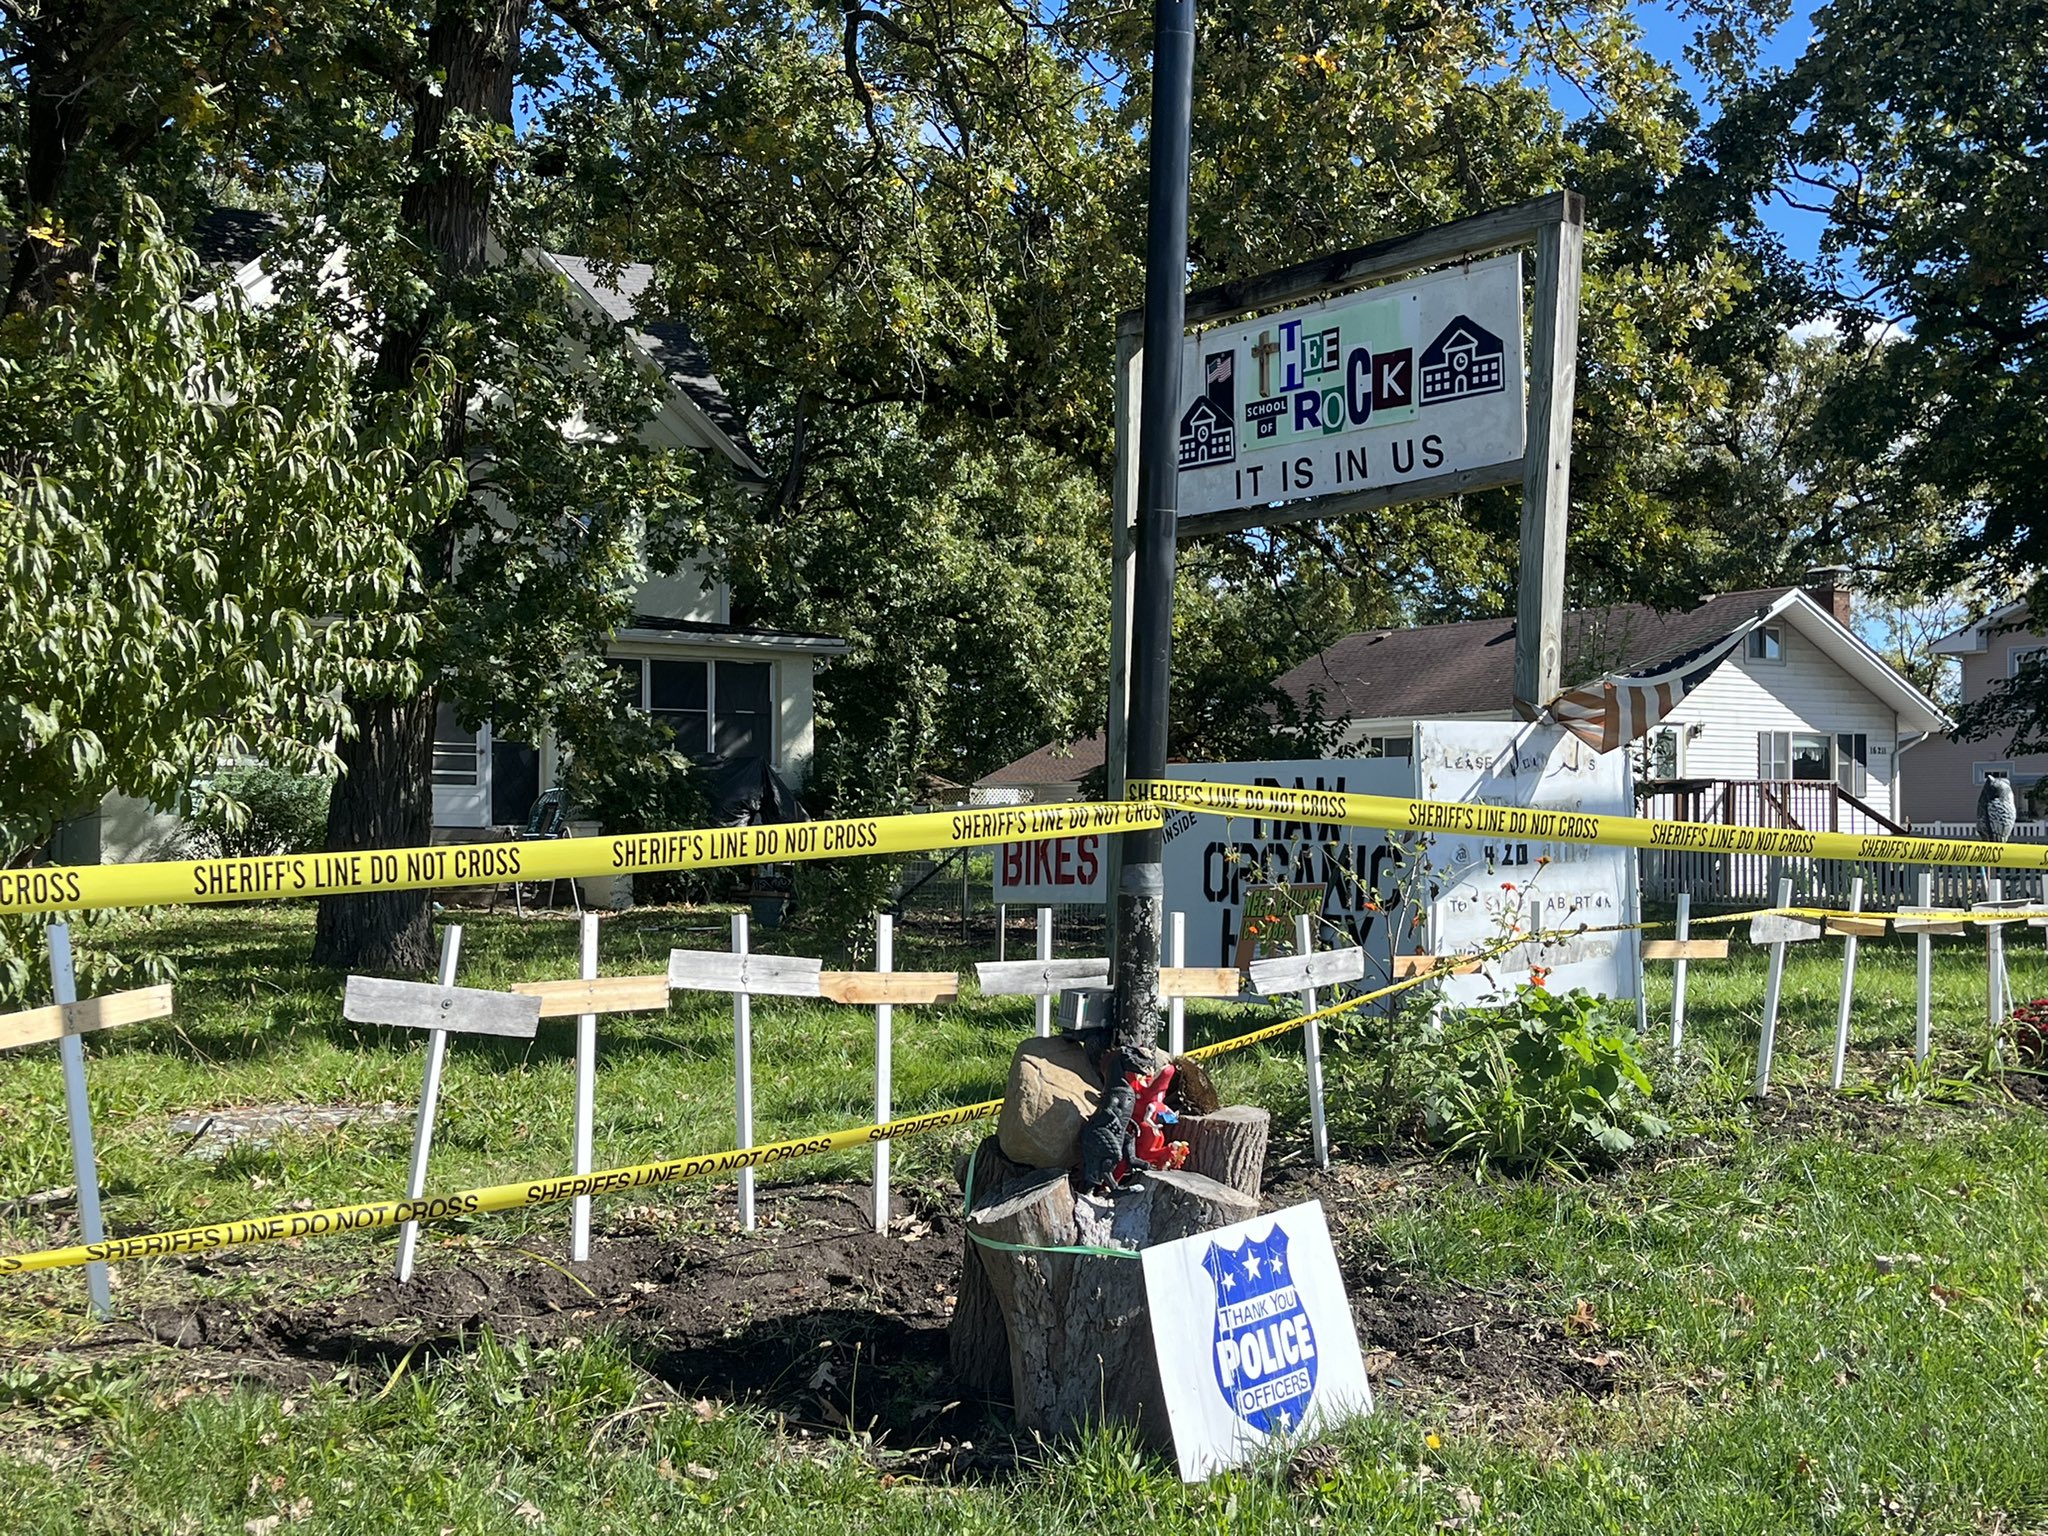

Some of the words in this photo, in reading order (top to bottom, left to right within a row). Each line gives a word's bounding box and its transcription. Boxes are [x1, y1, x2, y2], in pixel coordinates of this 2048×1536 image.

[1294, 347, 1408, 429] ROCK
[1246, 400, 1287, 418] SCHOOL
[1260, 422, 1273, 434] OF
[1235, 465, 1264, 500] IT
[1282, 457, 1314, 492] IS
[1335, 446, 1369, 484] IN
[1391, 434, 1445, 474] US
[1128, 783, 1203, 805] SHERIFF'S
[1207, 787, 1240, 809] LINE
[1246, 790, 1265, 812] DO
[1269, 792, 1297, 815] NOT
[1302, 794, 1347, 819] CROSS
[951, 811, 1027, 841] SHERIFF'S
[1031, 809, 1064, 833] LINE
[1069, 807, 1090, 830] DO
[1094, 804, 1120, 827] NOT
[1125, 803, 1164, 823] CROS
[1162, 811, 1198, 844] INSIDE
[1408, 804, 1474, 830] SHERIFF'S
[1477, 808, 1506, 833] LINE
[1509, 812, 1527, 835] DO
[1530, 814, 1556, 837] NOT
[1558, 816, 1599, 840] CROSS
[1650, 824, 1709, 847] SHERIFF'S
[1708, 827, 1737, 849] LINE
[1736, 829, 1754, 850] DO
[1755, 831, 1780, 852] NOT
[1778, 833, 1816, 854] CROSS
[612, 835, 704, 868] SHERIFF'S
[710, 831, 749, 860] LINE
[755, 829, 778, 856] DO
[785, 826, 819, 854] NOT
[823, 822, 878, 850] CROSS
[1001, 834, 1099, 887] BIKES
[1858, 839, 1911, 859] SHERIFF'S
[1909, 841, 1935, 861] LINE
[1933, 843, 1951, 861] DO
[1950, 845, 1972, 863] NOT
[1969, 845, 2004, 864] CROSS
[0, 872, 81, 906] CROSS
[193, 860, 306, 896] SHERIFF'S
[314, 856, 362, 889] LINE
[371, 854, 398, 884] DO
[406, 851, 447, 882] NOT
[454, 846, 521, 878] CROSS
[634, 1163, 681, 1187] LINE
[682, 1158, 716, 1179] DO
[717, 1150, 764, 1172] NOT
[763, 1138, 833, 1164] CROSS
[227, 1218, 285, 1245] LINE
[290, 1213, 330, 1236] DO
[335, 1205, 389, 1231] NOT
[394, 1194, 479, 1224] CROSS
[1219, 1300, 1269, 1329] THANK
[1269, 1292, 1295, 1315] YOU
[1216, 1313, 1316, 1388] POLICE
[1242, 1371, 1309, 1411] OFFICERS
